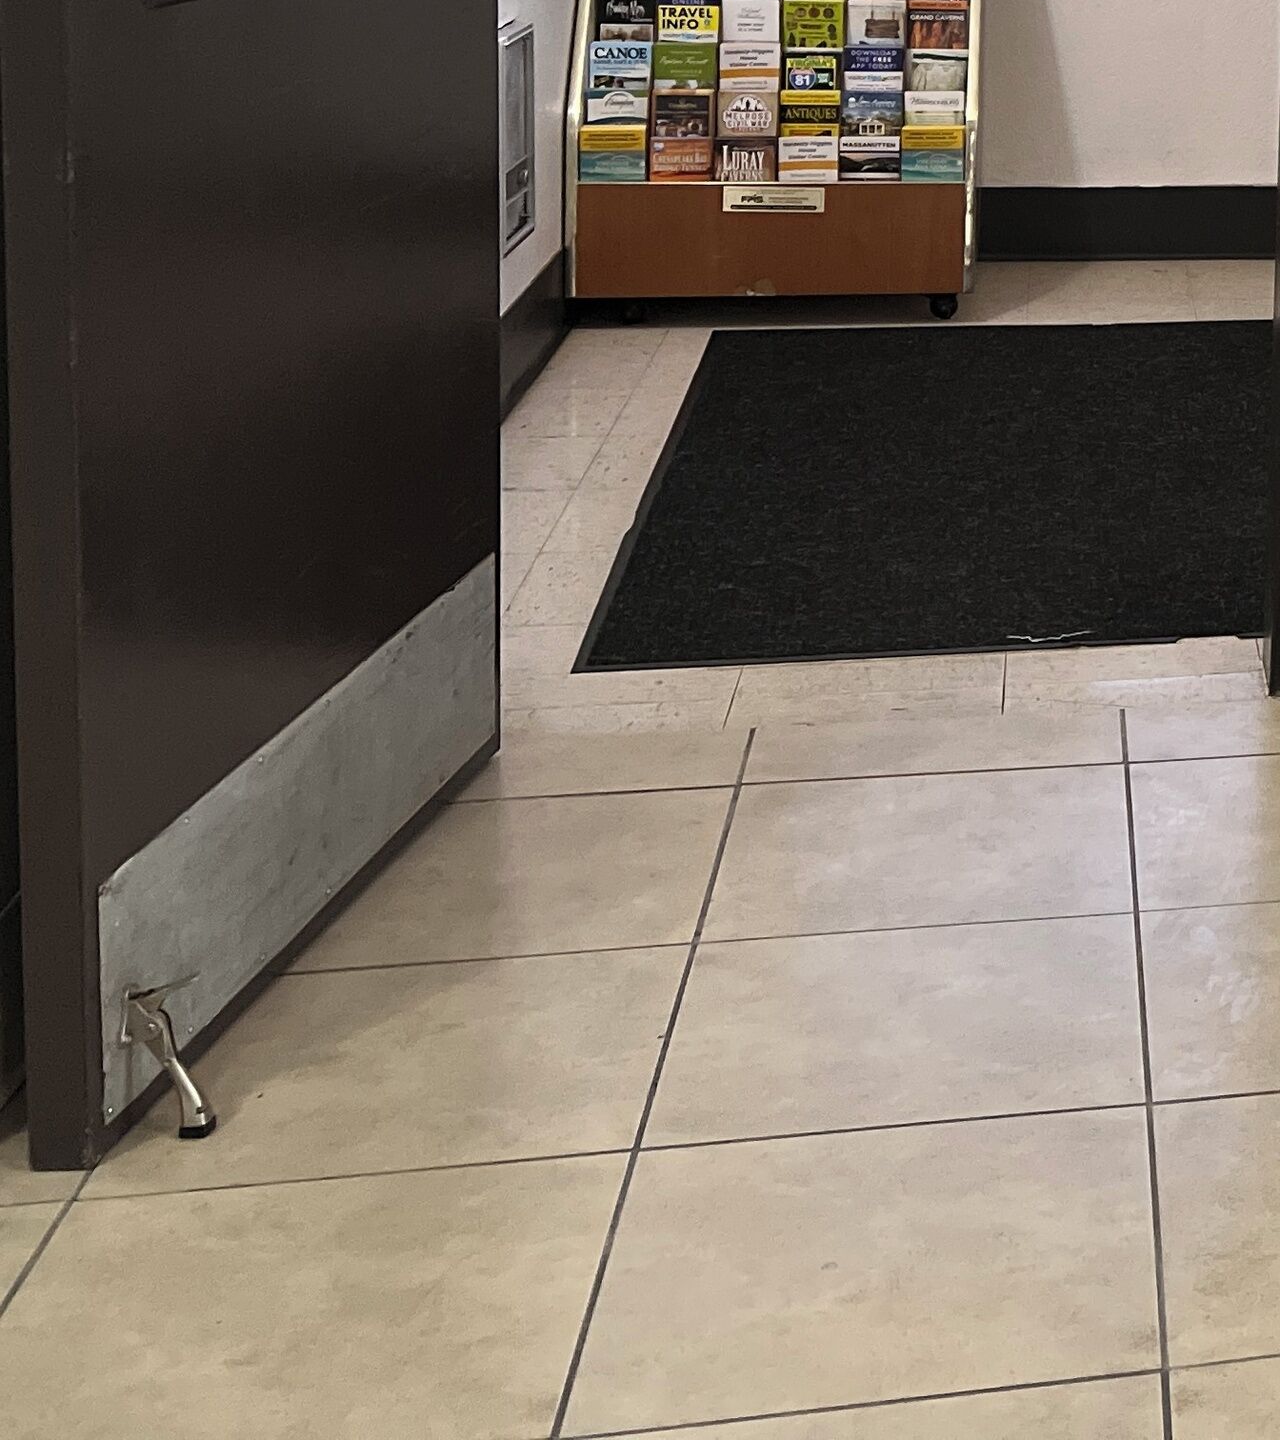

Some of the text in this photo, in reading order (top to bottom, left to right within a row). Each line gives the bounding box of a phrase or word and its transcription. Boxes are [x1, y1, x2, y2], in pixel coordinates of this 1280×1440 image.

[660, 7, 713, 18] TRAVEL
[662, 19, 699, 30] INFO
[594, 47, 648, 60] CANOE
[794, 75, 810, 86] 81
[725, 112, 769, 121] MELROSE
[785, 107, 837, 122] ANTIQUES
[722, 144, 765, 171] LURAY
